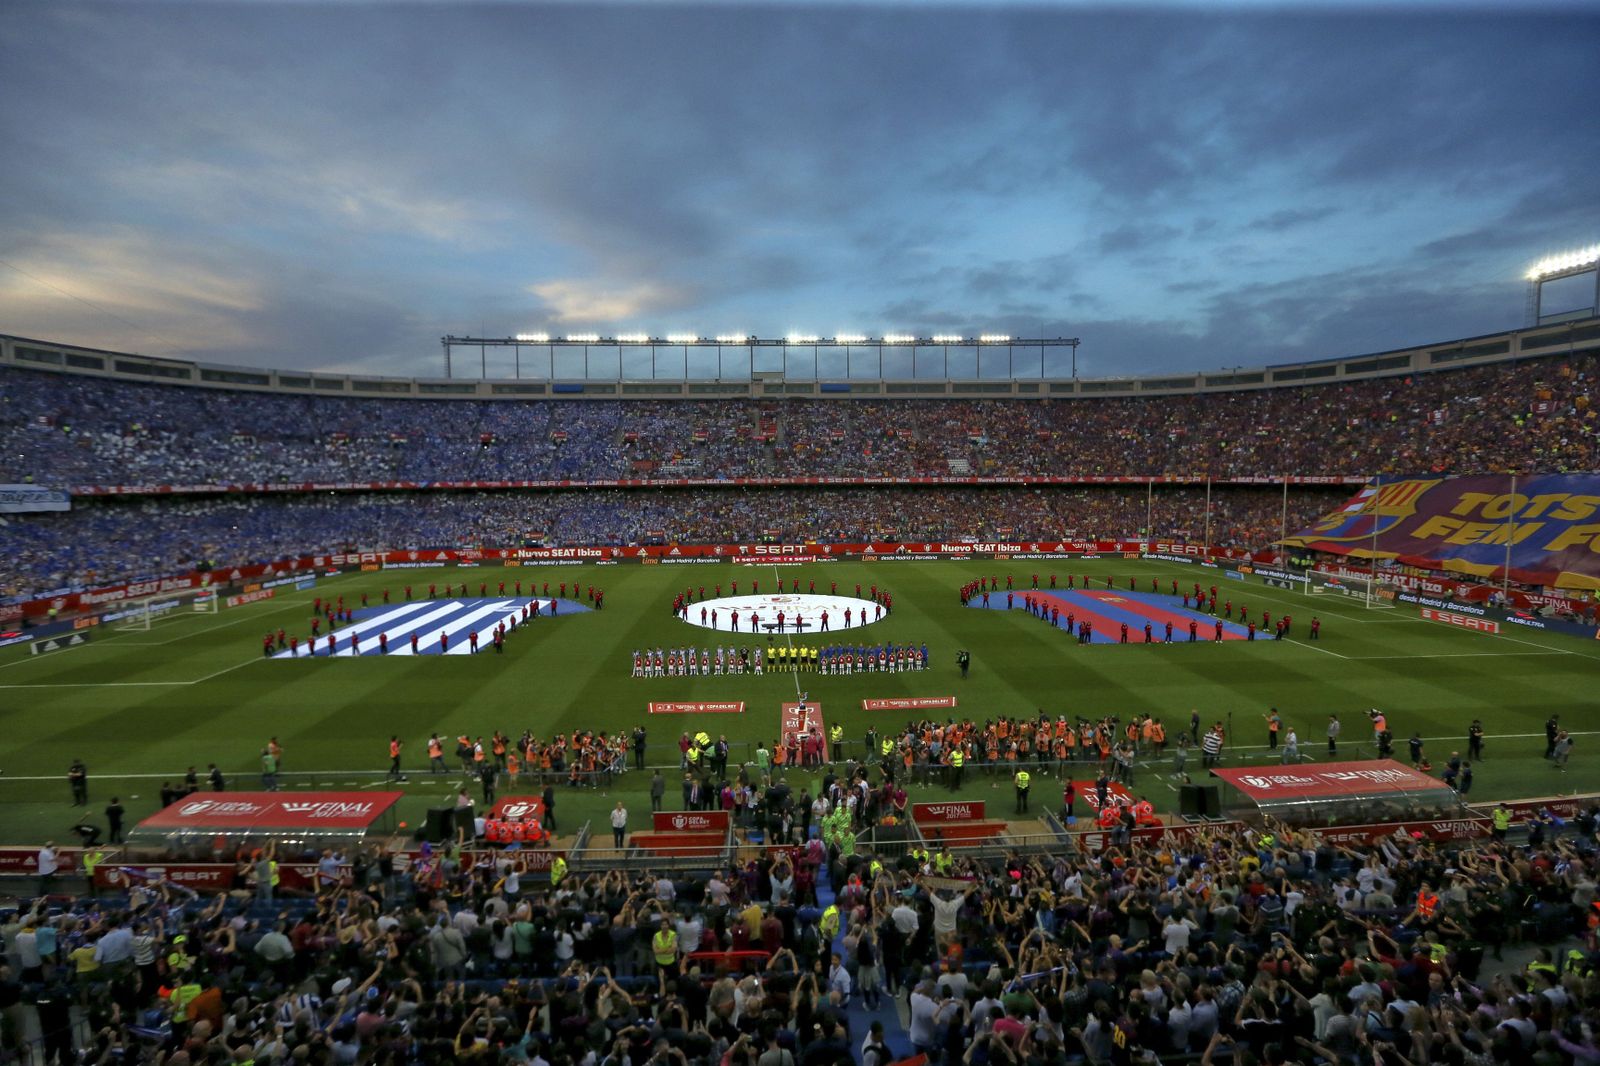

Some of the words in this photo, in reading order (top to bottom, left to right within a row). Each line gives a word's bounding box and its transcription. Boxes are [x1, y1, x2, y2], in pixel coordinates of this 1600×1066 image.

[1451, 492, 1600, 520] TOTS
[1410, 515, 1546, 546] FEM
[755, 546, 806, 554] SEAT
[1156, 544, 1210, 555] SEAT
[331, 552, 390, 565] SEAT
[361, 563, 380, 572] Lima
[1238, 566, 1252, 574] Lima
[1269, 570, 1284, 578] Madrid
[1338, 567, 1372, 580] Nuevo
[1377, 572, 1407, 586] SEAT
[80, 590, 126, 604] Nuevo
[127, 581, 160, 597] SEAT
[243, 588, 273, 602] SEAT
[1352, 590, 1380, 602] SEAT
[1376, 588, 1394, 598] Lima
[1420, 597, 1442, 608] Madrid
[1448, 602, 1485, 615] Barcelona
[1544, 598, 1572, 610] FINAL
[1438, 612, 1494, 632] SEAT
[1358, 768, 1411, 778] FINAL
[319, 802, 374, 812] FINAL
[946, 805, 972, 814] FINAL
[1452, 822, 1480, 832] FINAL
[171, 872, 220, 880] SEAT
